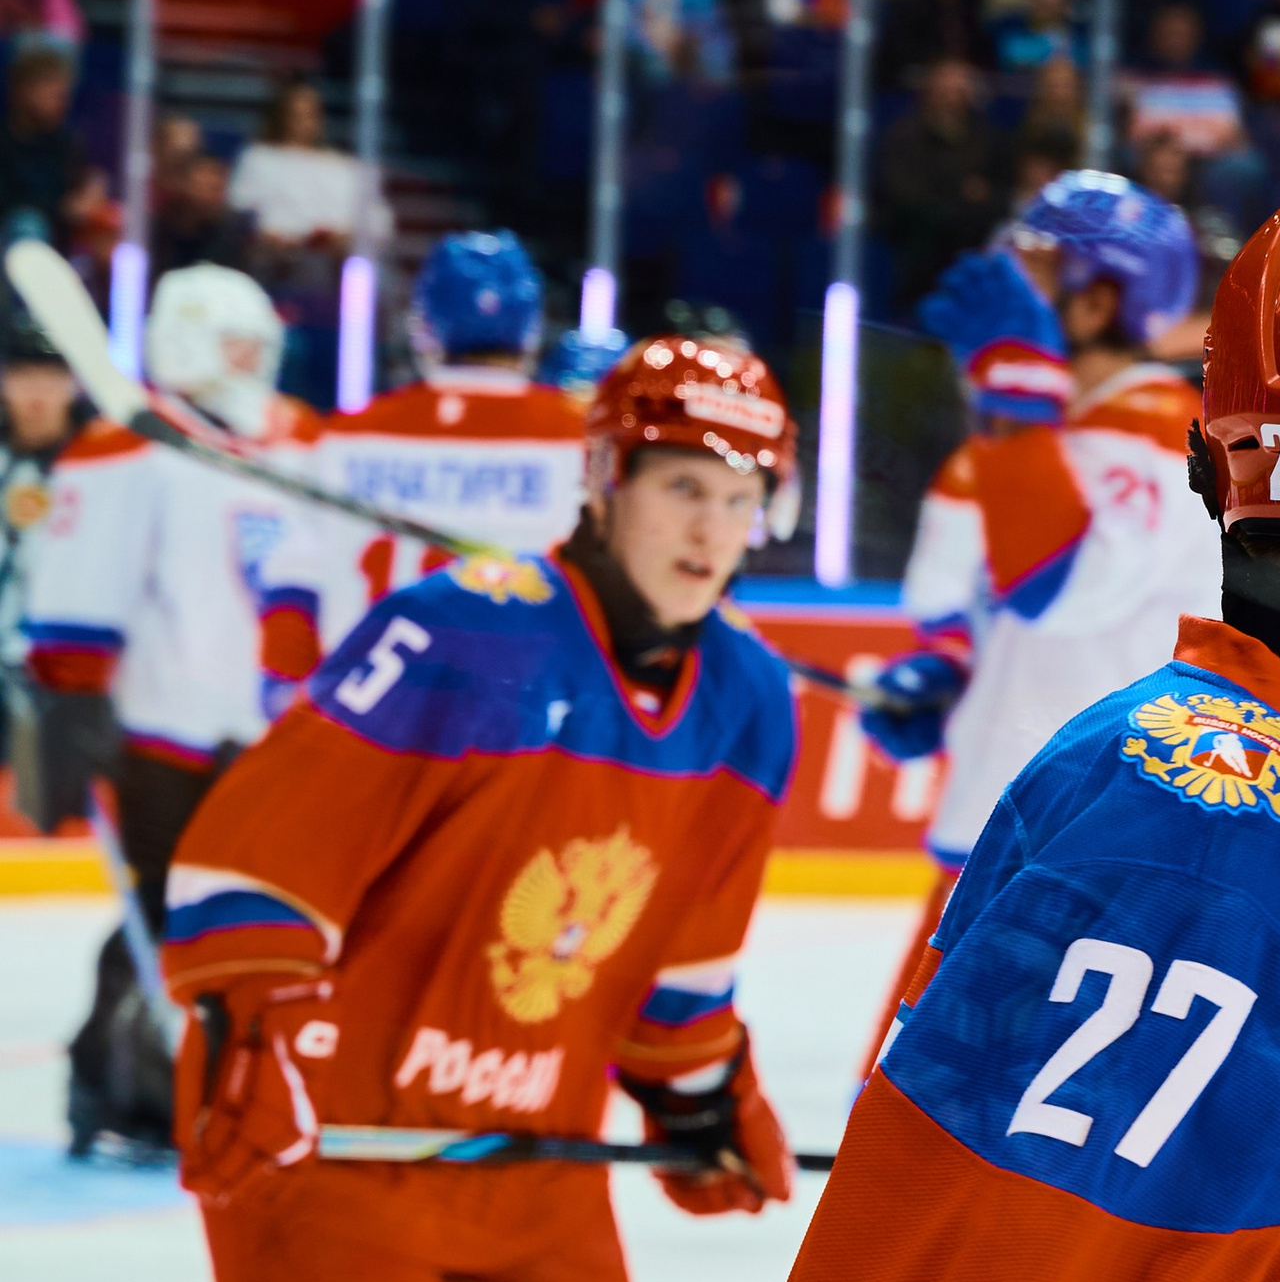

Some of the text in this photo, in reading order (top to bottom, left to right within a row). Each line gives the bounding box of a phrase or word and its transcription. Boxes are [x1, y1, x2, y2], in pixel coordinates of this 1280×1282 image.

[335, 617, 431, 715] 5
[1192, 716, 1239, 732] RUSSIA
[1007, 938, 1258, 1168] 27
